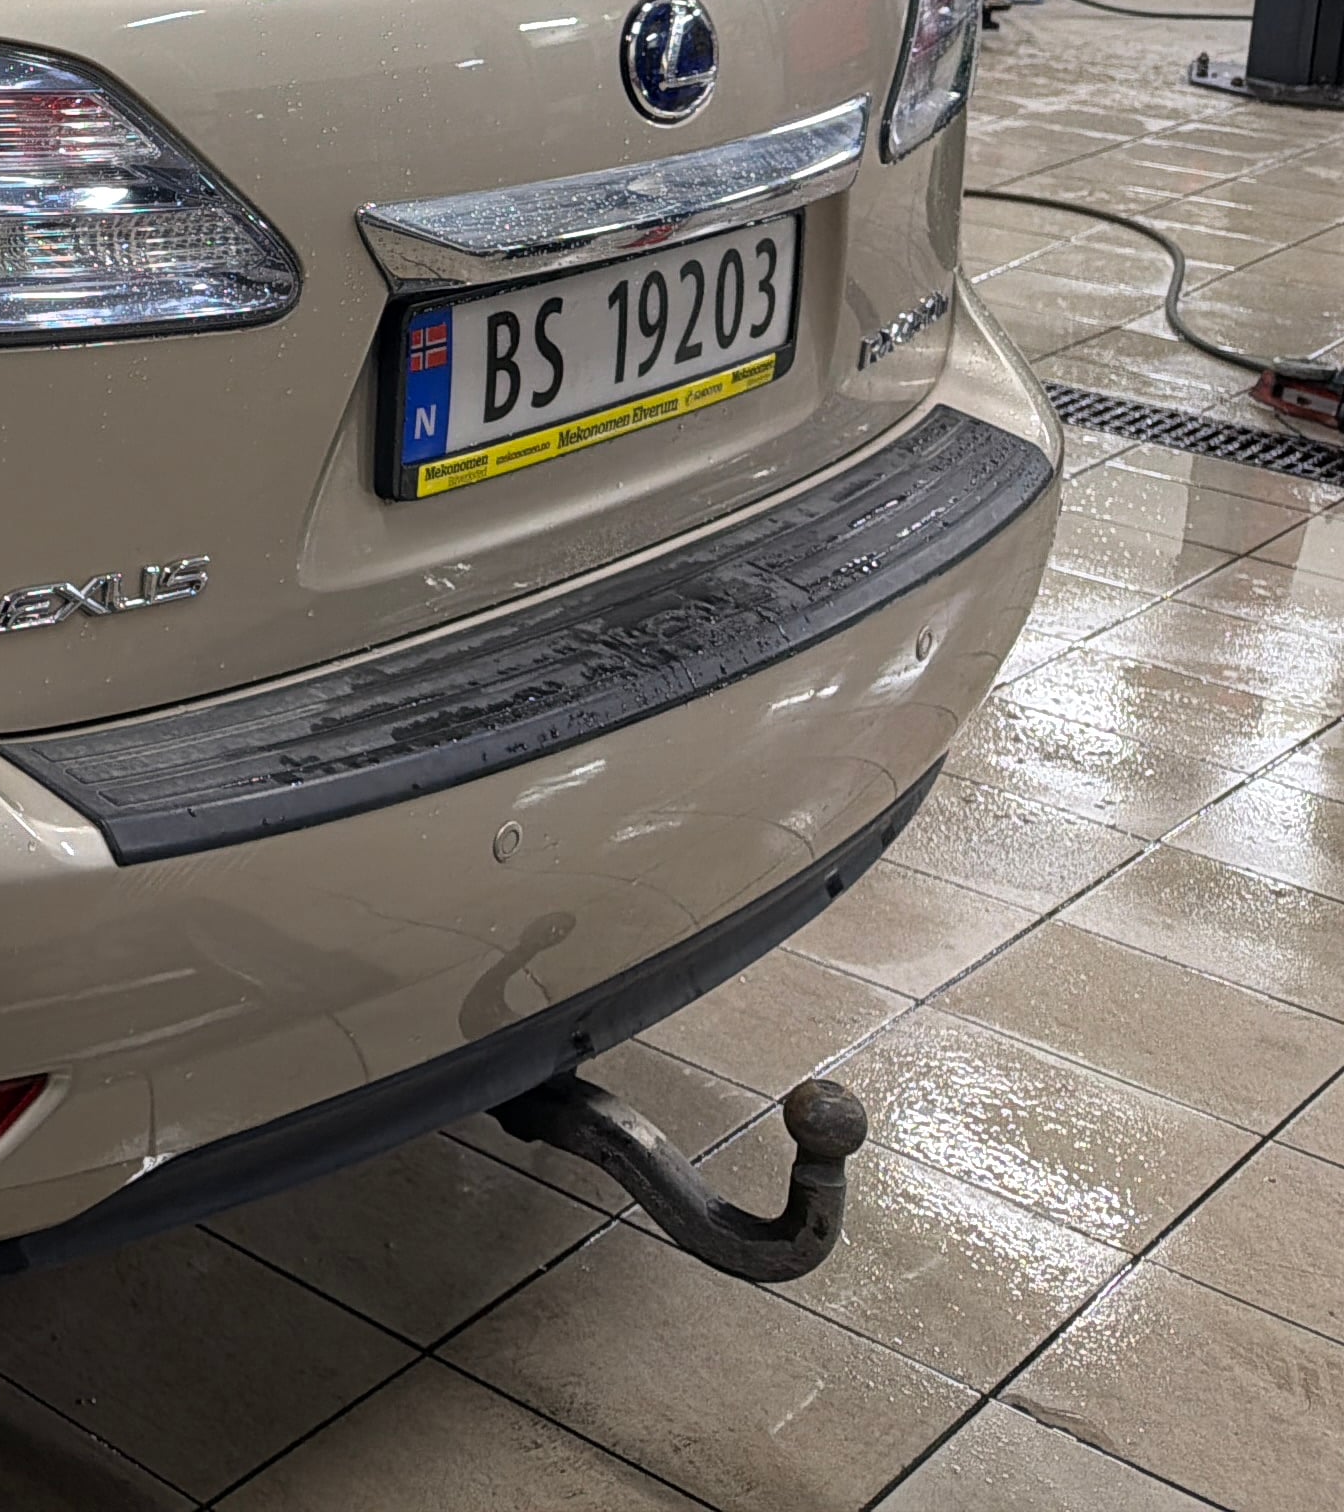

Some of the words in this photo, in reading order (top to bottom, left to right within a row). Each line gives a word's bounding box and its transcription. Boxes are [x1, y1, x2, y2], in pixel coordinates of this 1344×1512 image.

[483, 296, 565, 424] BS
[607, 237, 777, 385] 19203
[413, 403, 437, 440] N
[557, 413, 631, 450] Mekonomen
[631, 398, 679, 425] Elverum
[424, 454, 489, 482] Mekonomen
